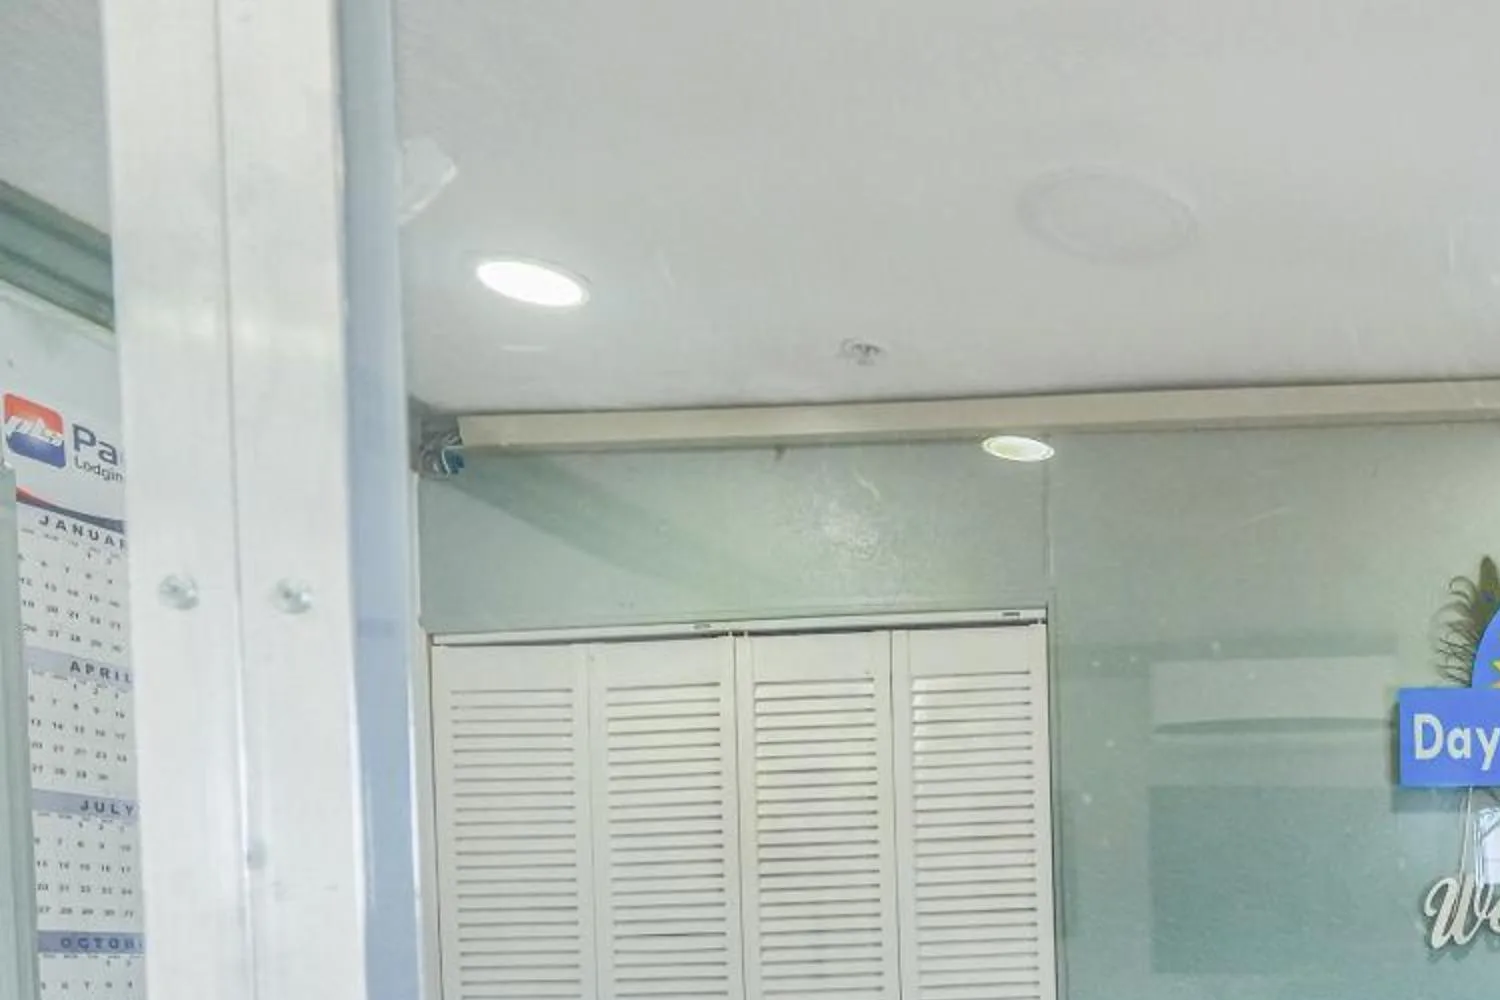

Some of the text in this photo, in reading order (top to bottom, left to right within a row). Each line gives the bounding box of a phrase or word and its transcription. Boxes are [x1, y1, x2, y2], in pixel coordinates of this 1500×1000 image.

[72, 423, 123, 467] Pa
[69, 660, 132, 685] APRIL
[79, 798, 134, 817] JULY
[59, 936, 143, 951] OCTOB
